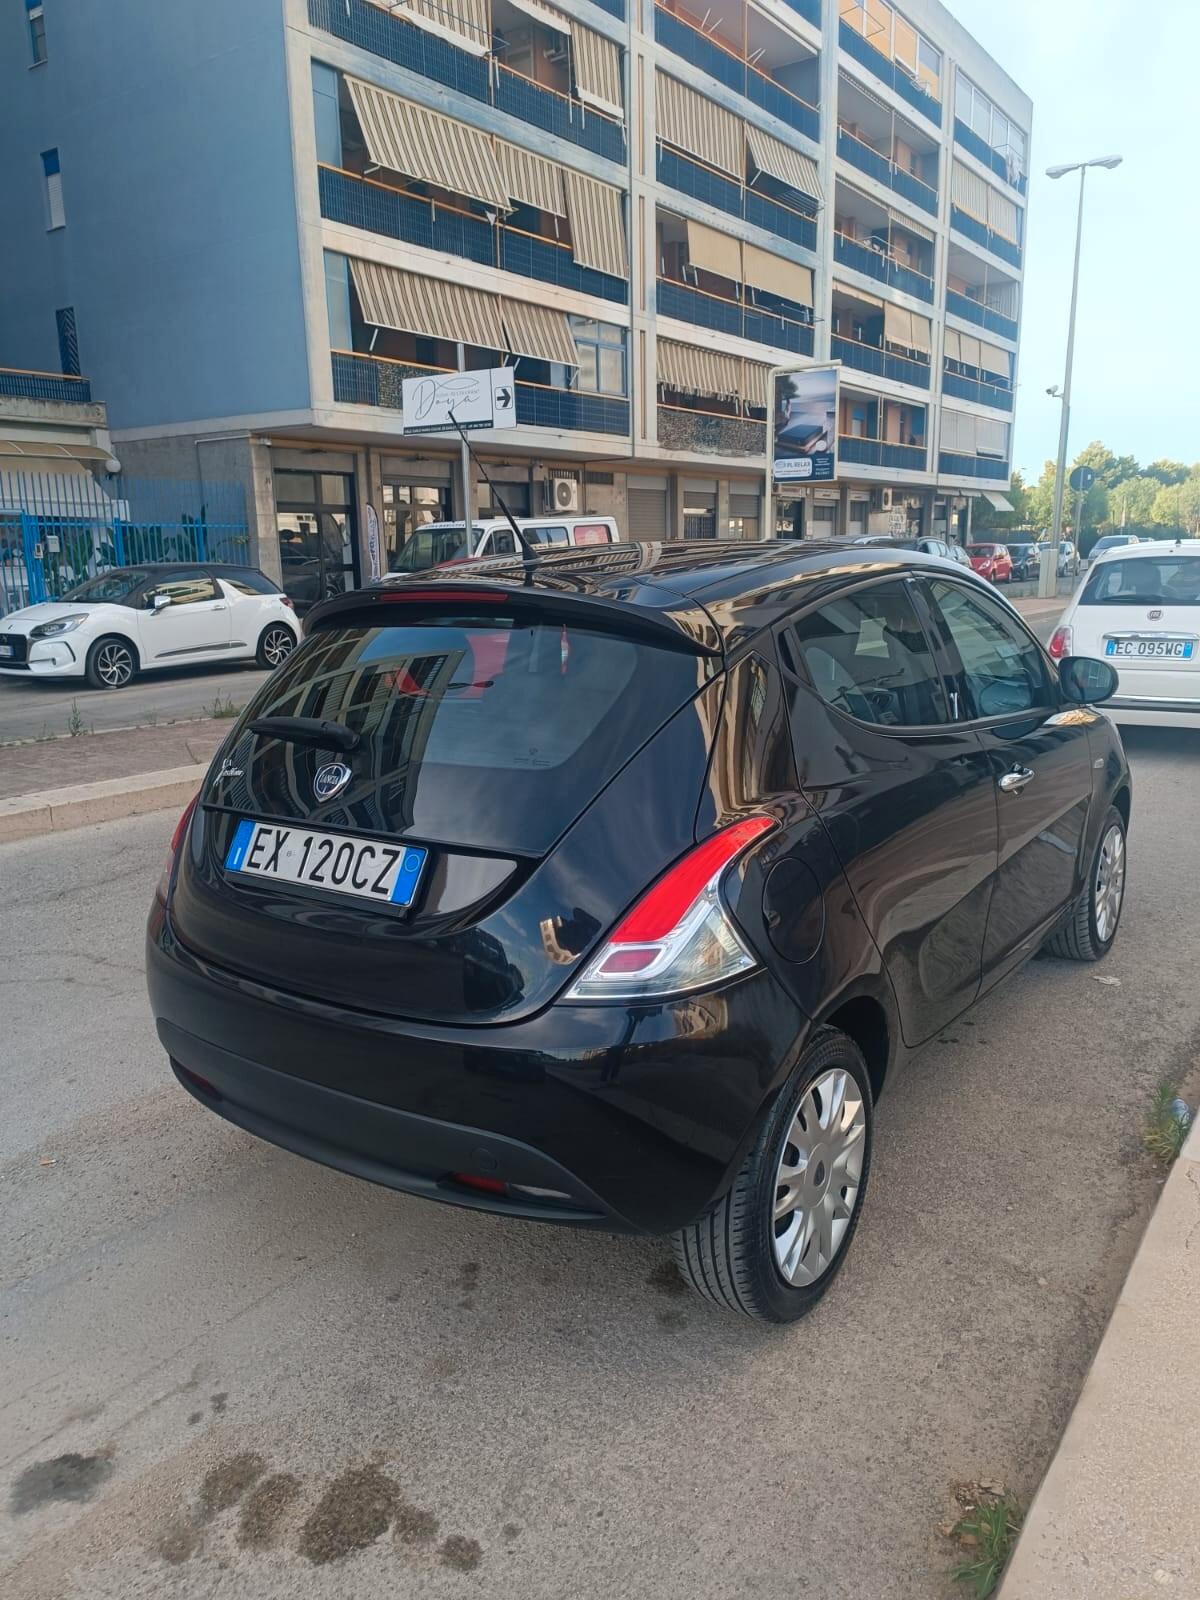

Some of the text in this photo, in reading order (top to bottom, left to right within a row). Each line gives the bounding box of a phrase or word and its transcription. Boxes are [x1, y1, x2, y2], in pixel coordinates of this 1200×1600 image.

[1116, 642, 1183, 656] EC 095WG
[246, 827, 401, 896] EX 120CZ
